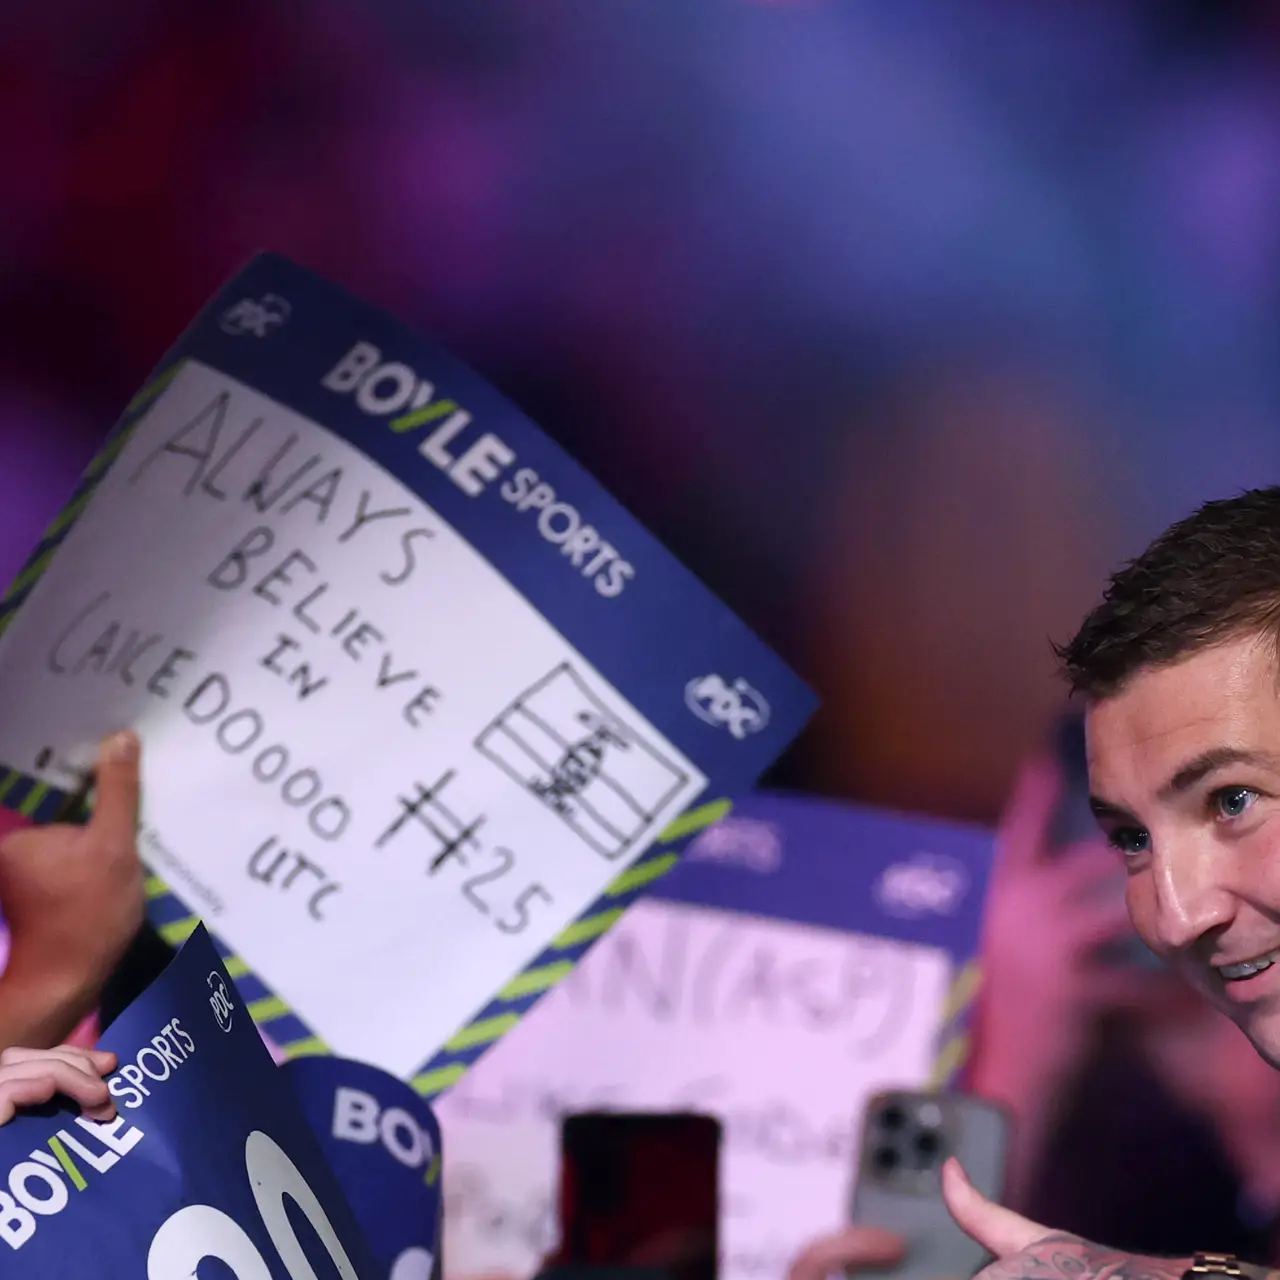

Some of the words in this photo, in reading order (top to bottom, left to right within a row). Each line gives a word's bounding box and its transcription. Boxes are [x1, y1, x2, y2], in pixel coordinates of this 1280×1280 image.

[127, 389, 437, 586] ALWAYS
[321, 341, 517, 498] BOYLE
[501, 468, 635, 599] SPORTS
[206, 525, 443, 728] BELIEVE
[257, 632, 330, 702] IN
[247, 836, 341, 921] UTC
[373, 767, 555, 935] #25
[107, 1018, 195, 1108] SPORTS
[207, 974, 234, 1031] PDC
